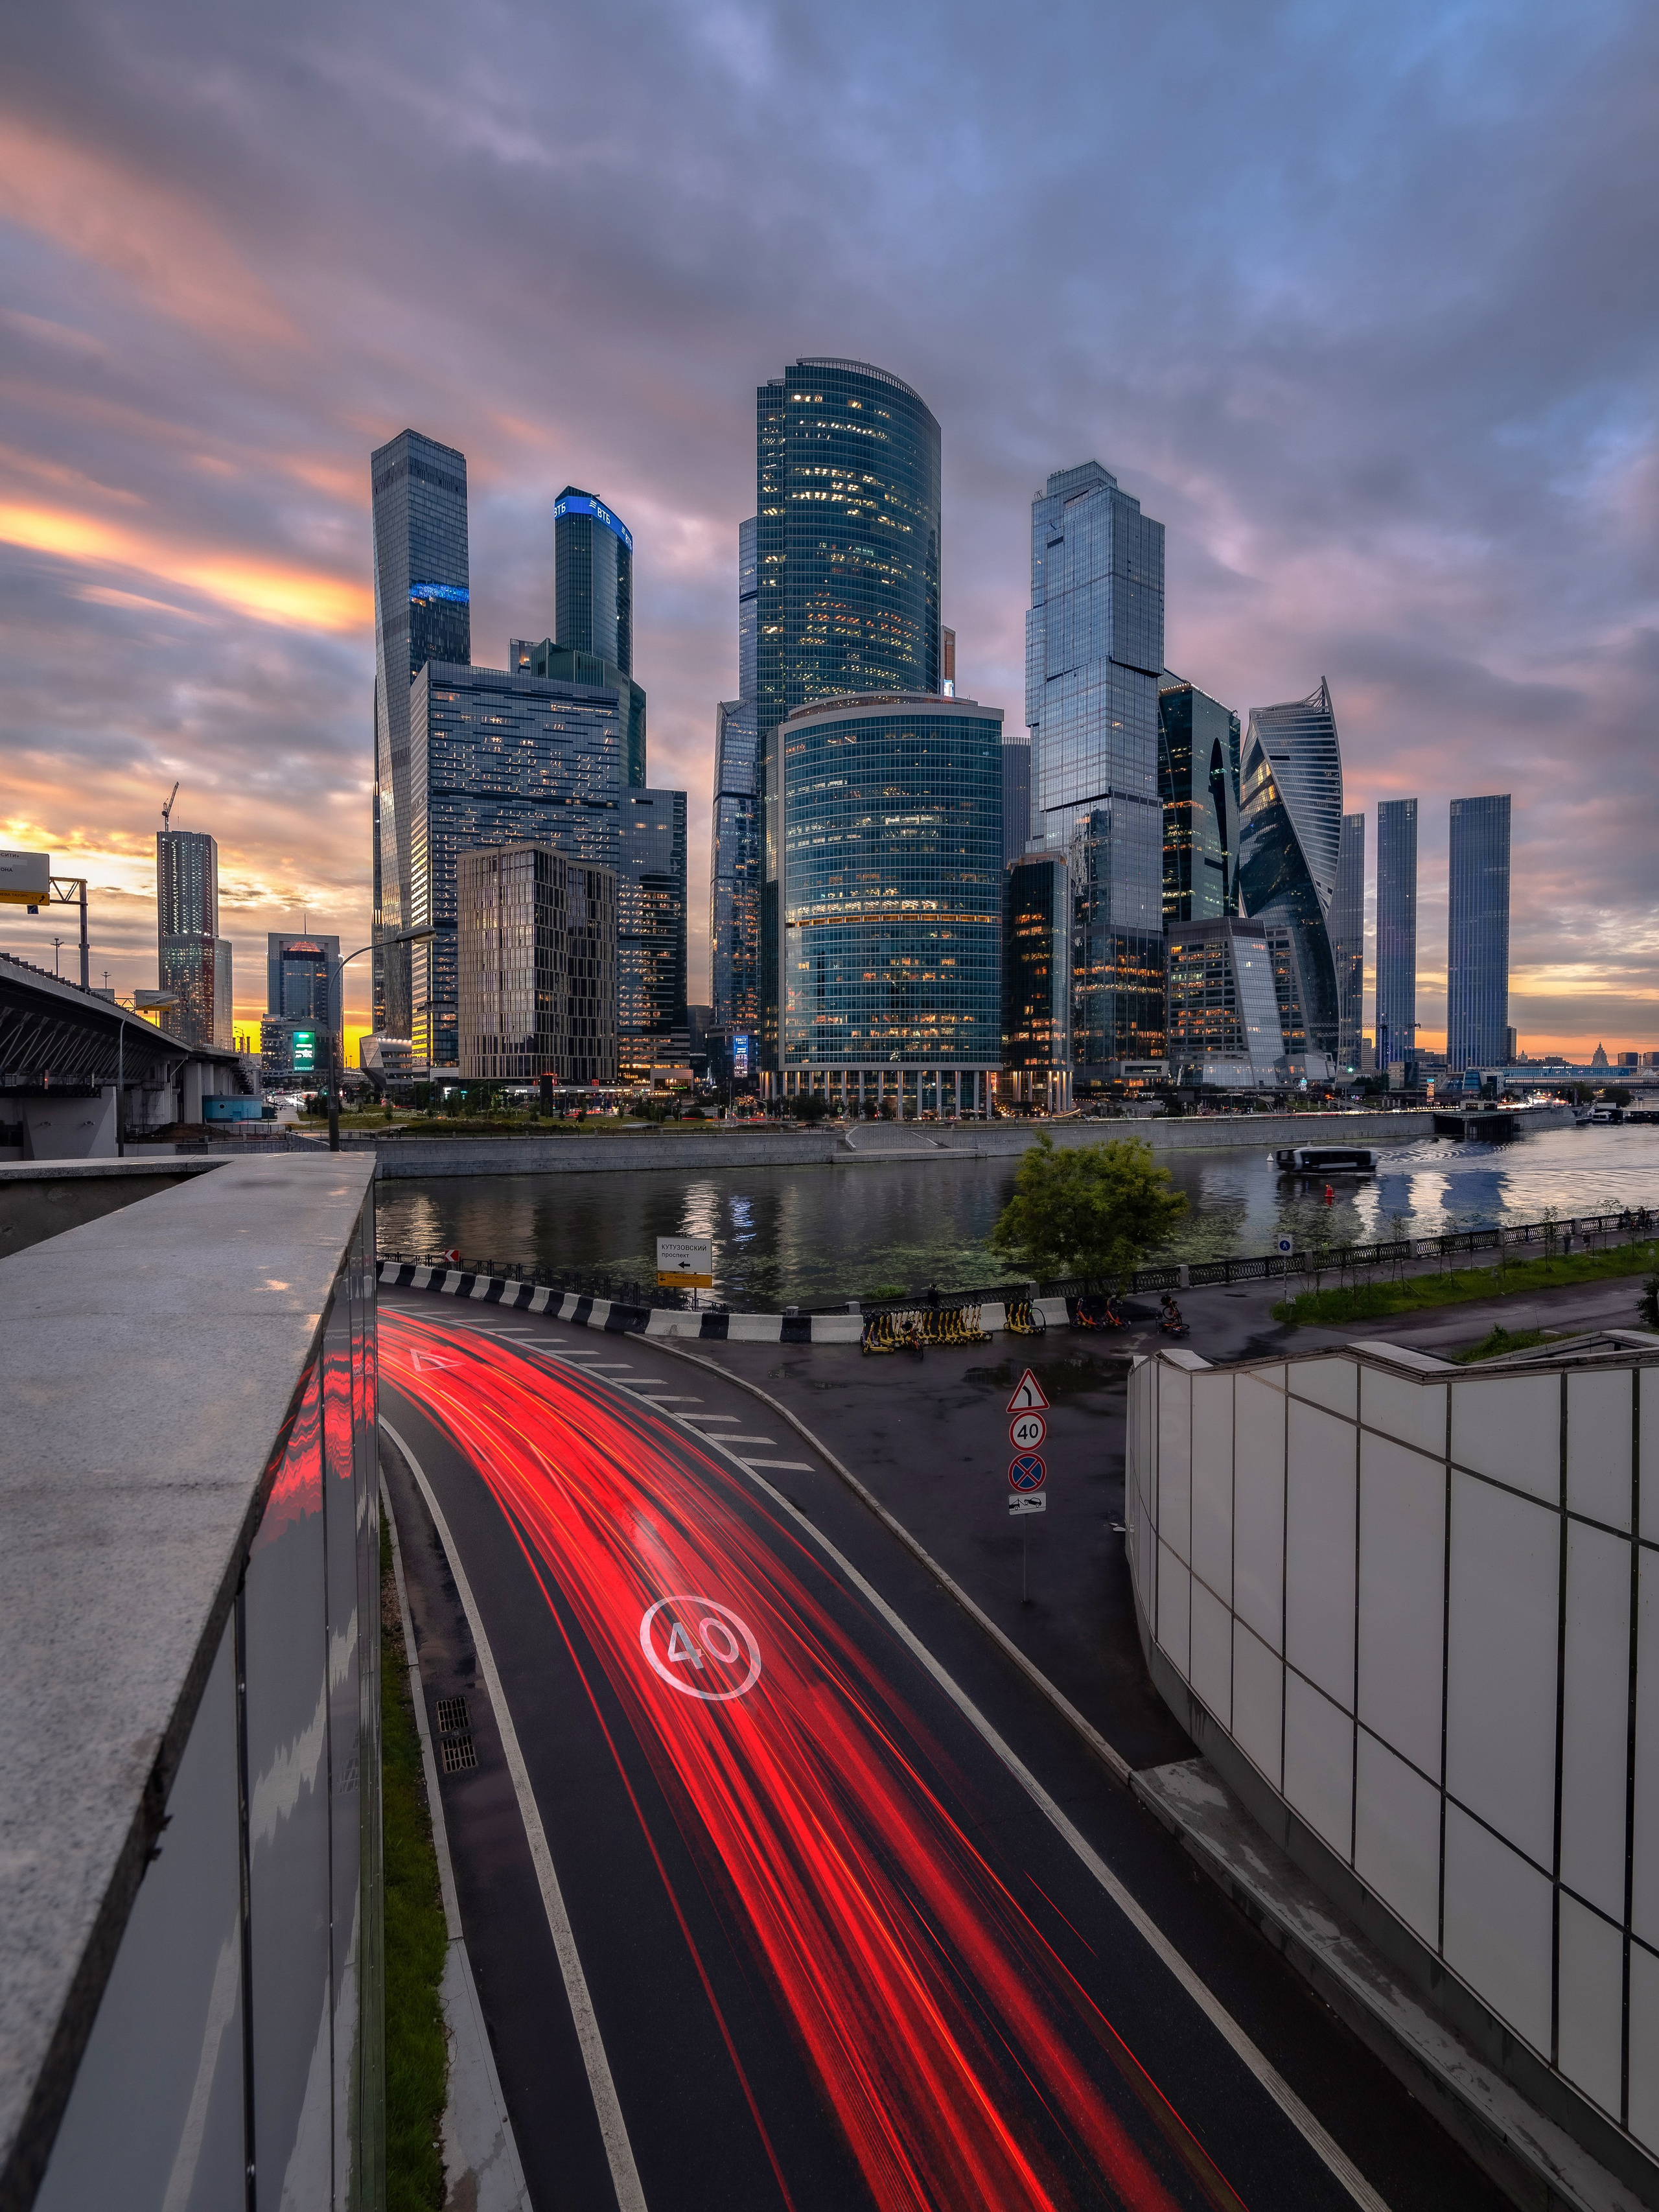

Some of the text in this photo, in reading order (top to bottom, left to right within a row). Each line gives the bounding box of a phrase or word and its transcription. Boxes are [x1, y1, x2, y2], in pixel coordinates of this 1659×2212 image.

[597, 507, 610, 524] ВТБ
[1017, 1423, 1039, 1439] 40
[667, 1617, 739, 1670] 40
